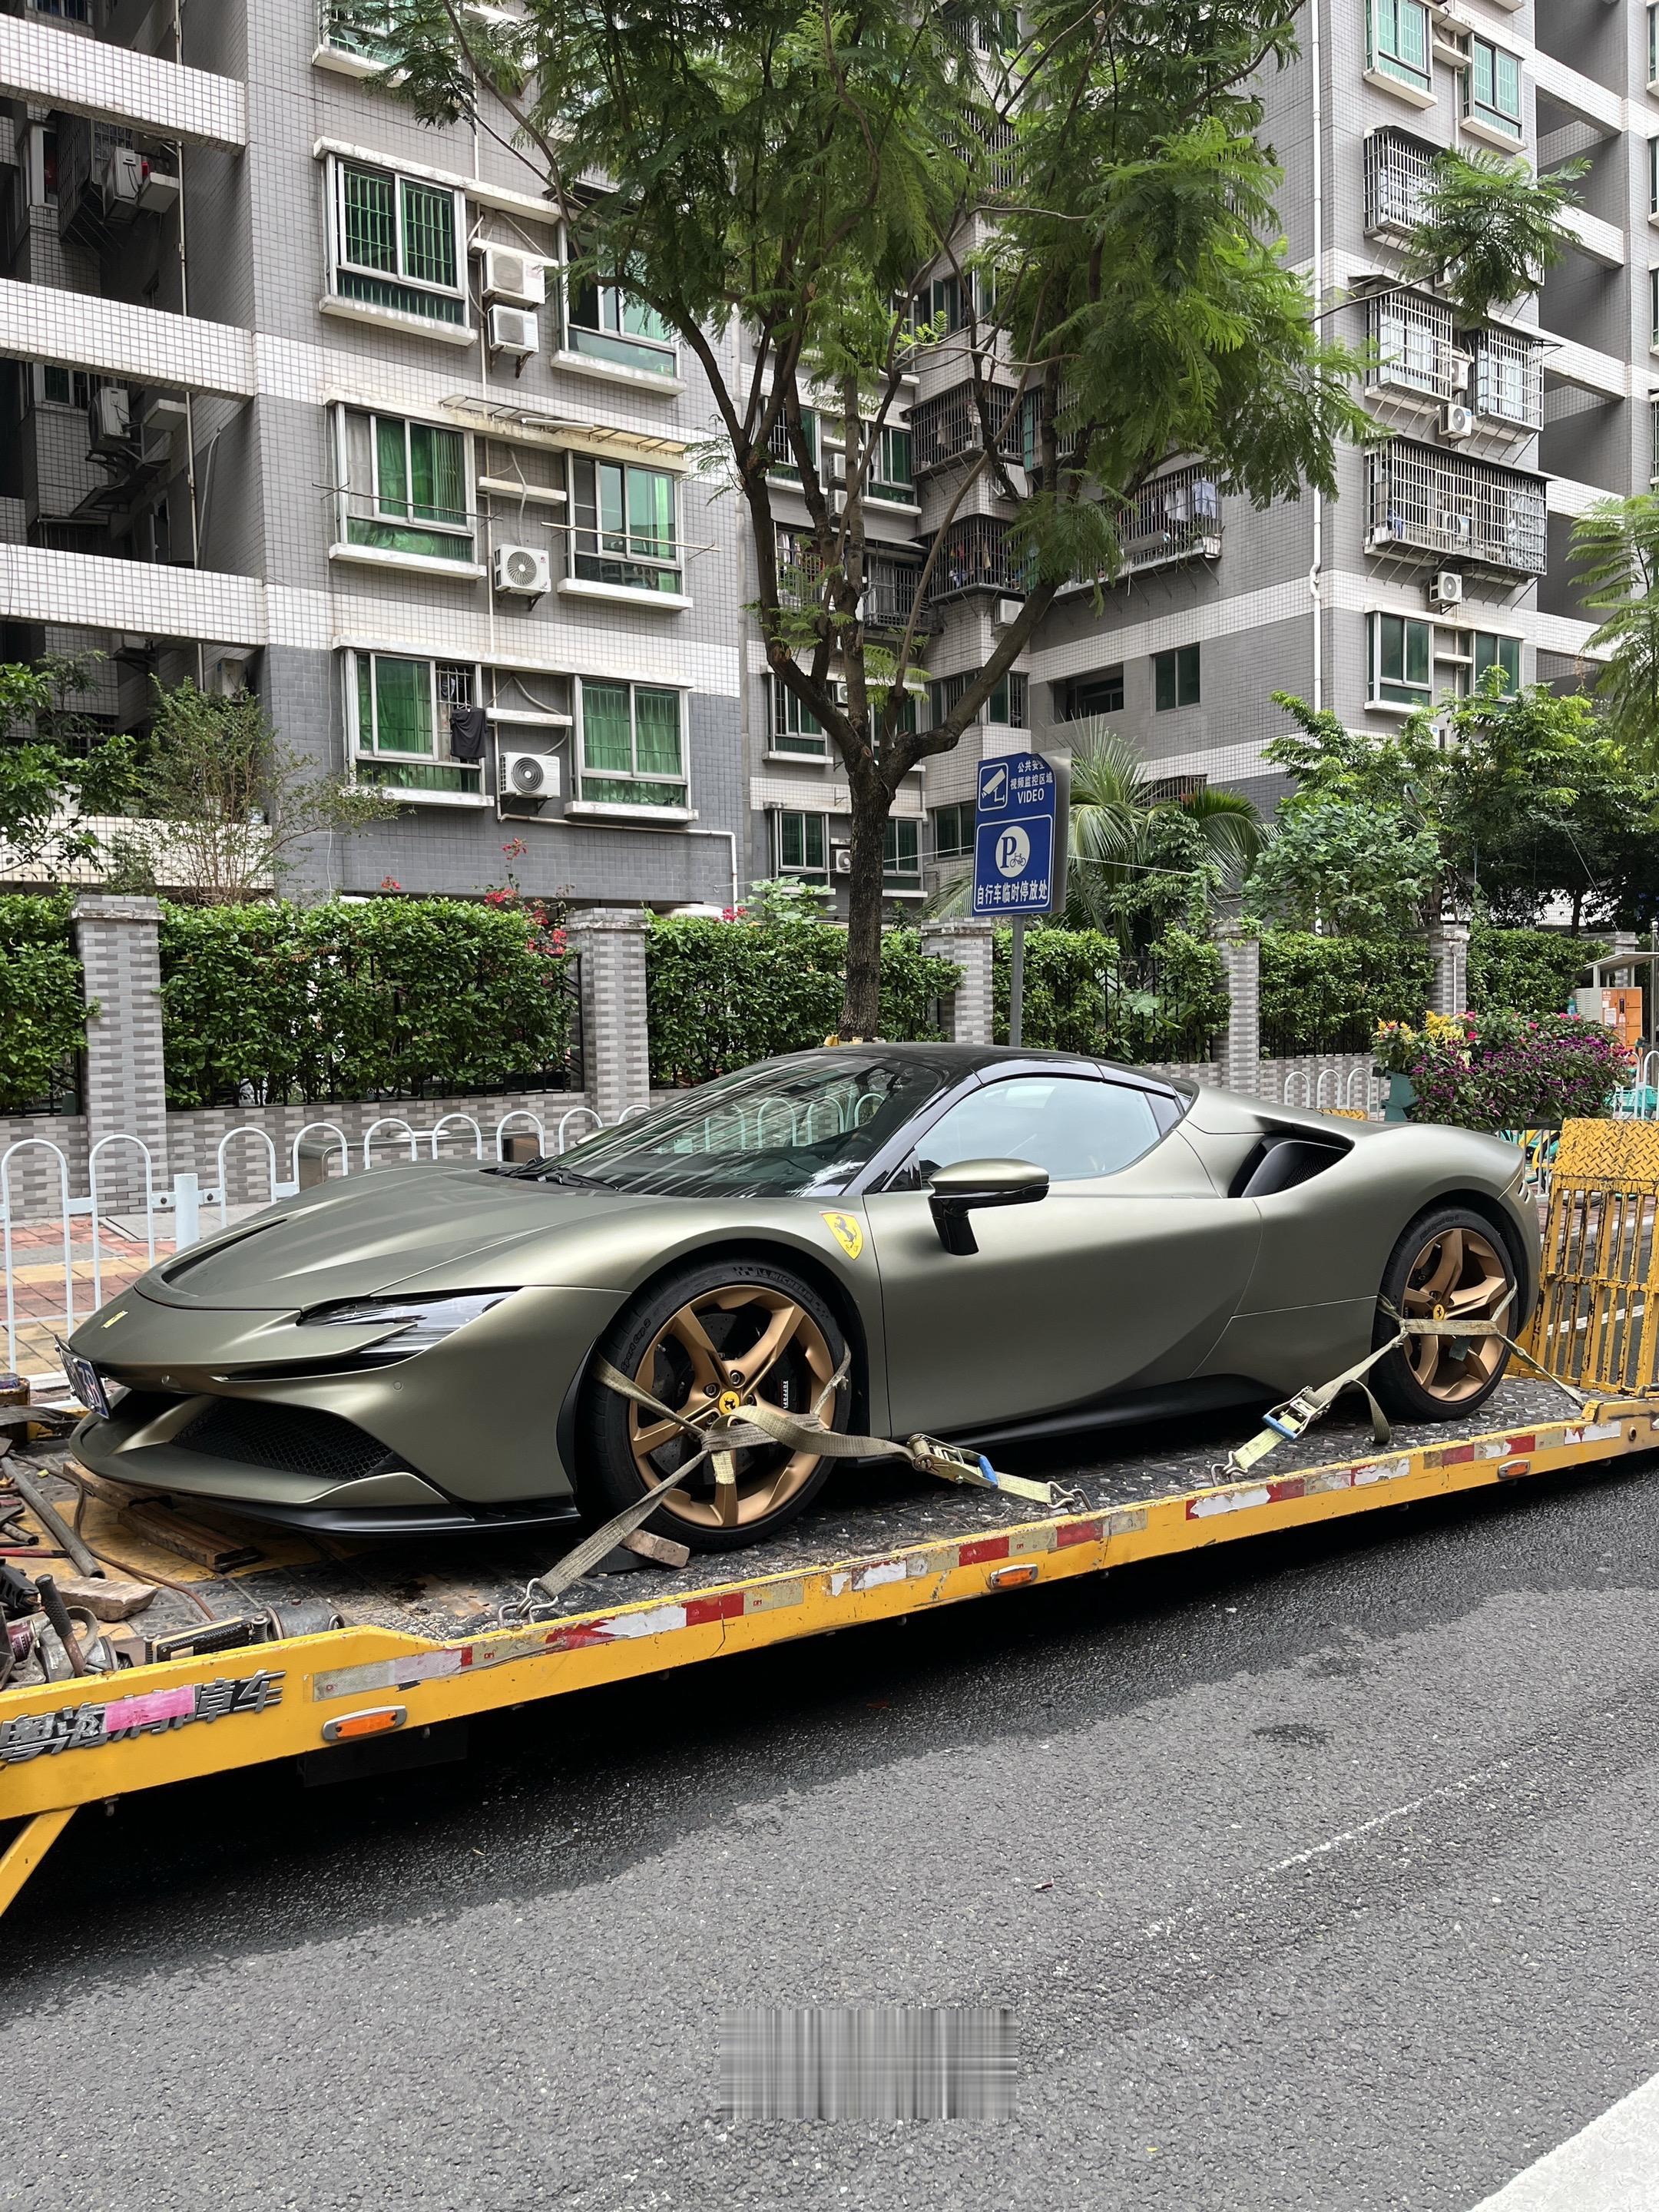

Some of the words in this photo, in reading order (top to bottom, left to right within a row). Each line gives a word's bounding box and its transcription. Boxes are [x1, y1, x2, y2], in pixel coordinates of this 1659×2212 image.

[1010, 771, 1053, 790] 视频监控区域
[1017, 787, 1045, 804] VIDEO
[1000, 836, 1017, 869] P
[976, 878, 1048, 906] 自行车临时停放处
[0, 1669, 287, 1763] 粤海障车
